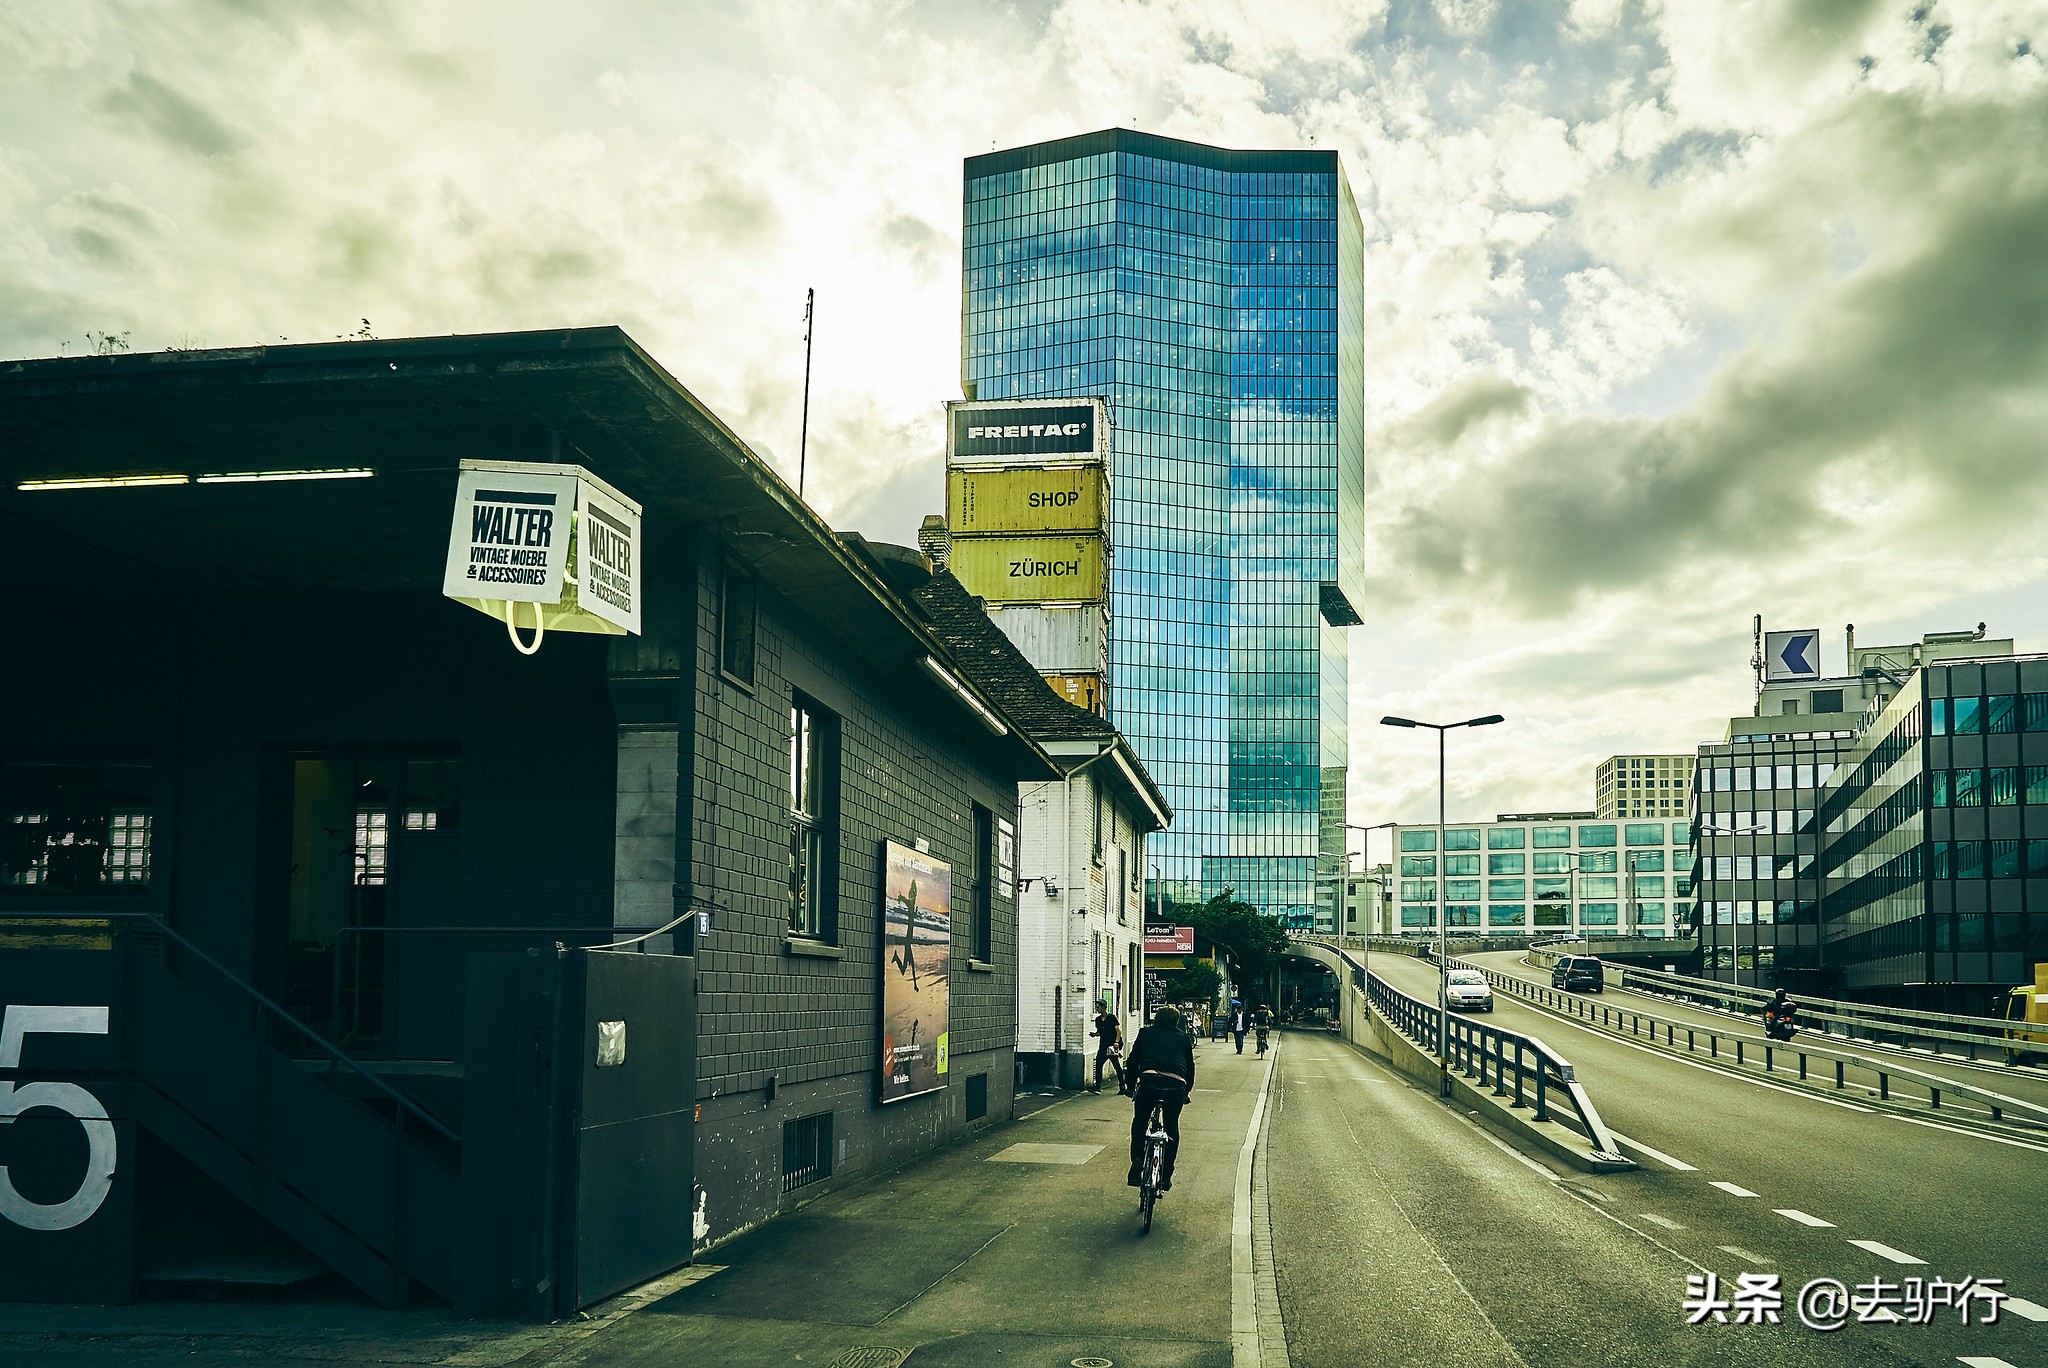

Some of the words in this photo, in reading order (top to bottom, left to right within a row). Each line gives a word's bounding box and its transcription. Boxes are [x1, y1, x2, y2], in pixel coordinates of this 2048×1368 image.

[1028, 491, 1080, 508] SHOP
[472, 505, 554, 548] WALTER
[470, 546, 509, 565] VINTAGE
[510, 549, 548, 567] MOEBEL
[587, 517, 631, 578] WALTER
[467, 564, 477, 579] &
[478, 565, 547, 586] ACCESSOIRES
[589, 560, 612, 583] VINTAGE
[611, 570, 631, 597] MOEBEL
[1009, 560, 1079, 578] ZÜRICH
[589, 578, 596, 594] &
[596, 585, 632, 614] ACCESSOIRES
[700, 916, 707, 933] 15
[1176, 942, 1192, 951] NEIN
